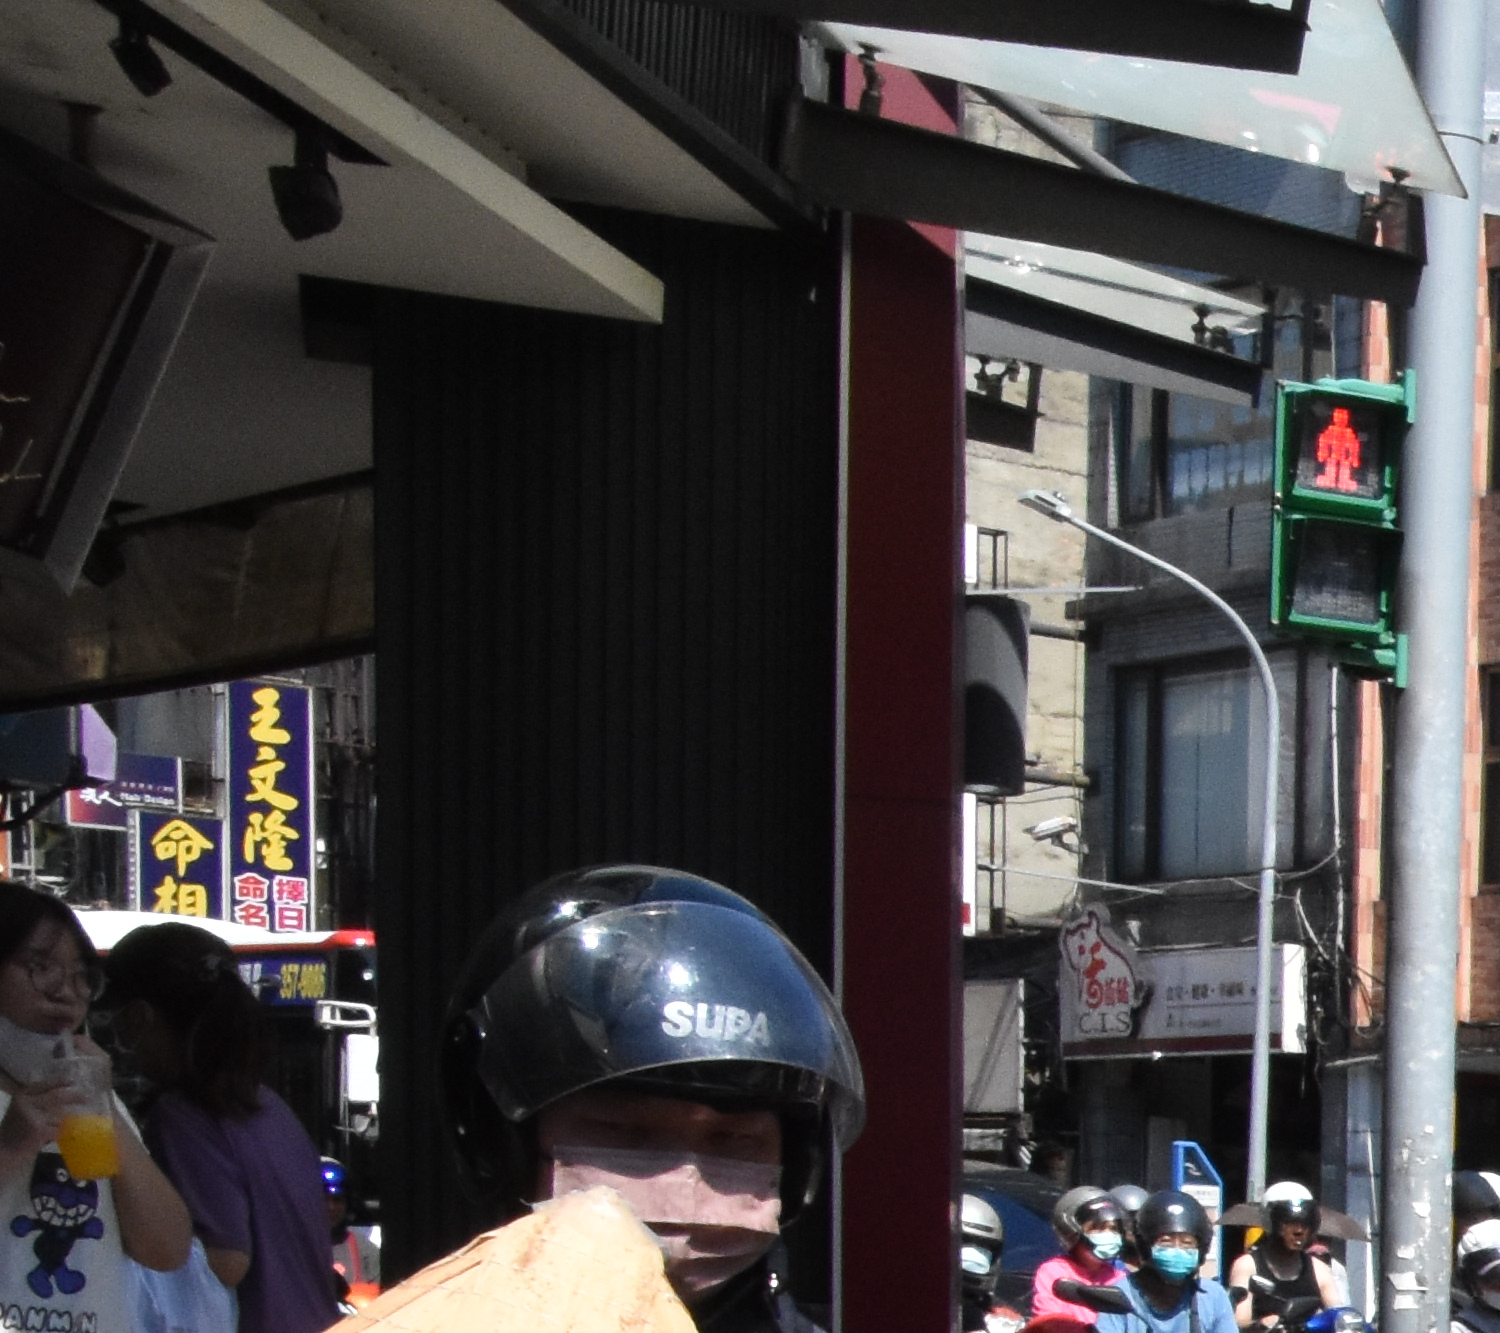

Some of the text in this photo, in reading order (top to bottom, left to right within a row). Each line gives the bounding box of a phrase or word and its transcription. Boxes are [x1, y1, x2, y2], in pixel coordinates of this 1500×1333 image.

[243, 687, 299, 871] 王文隆
[661, 1000, 771, 1046] SUPA
